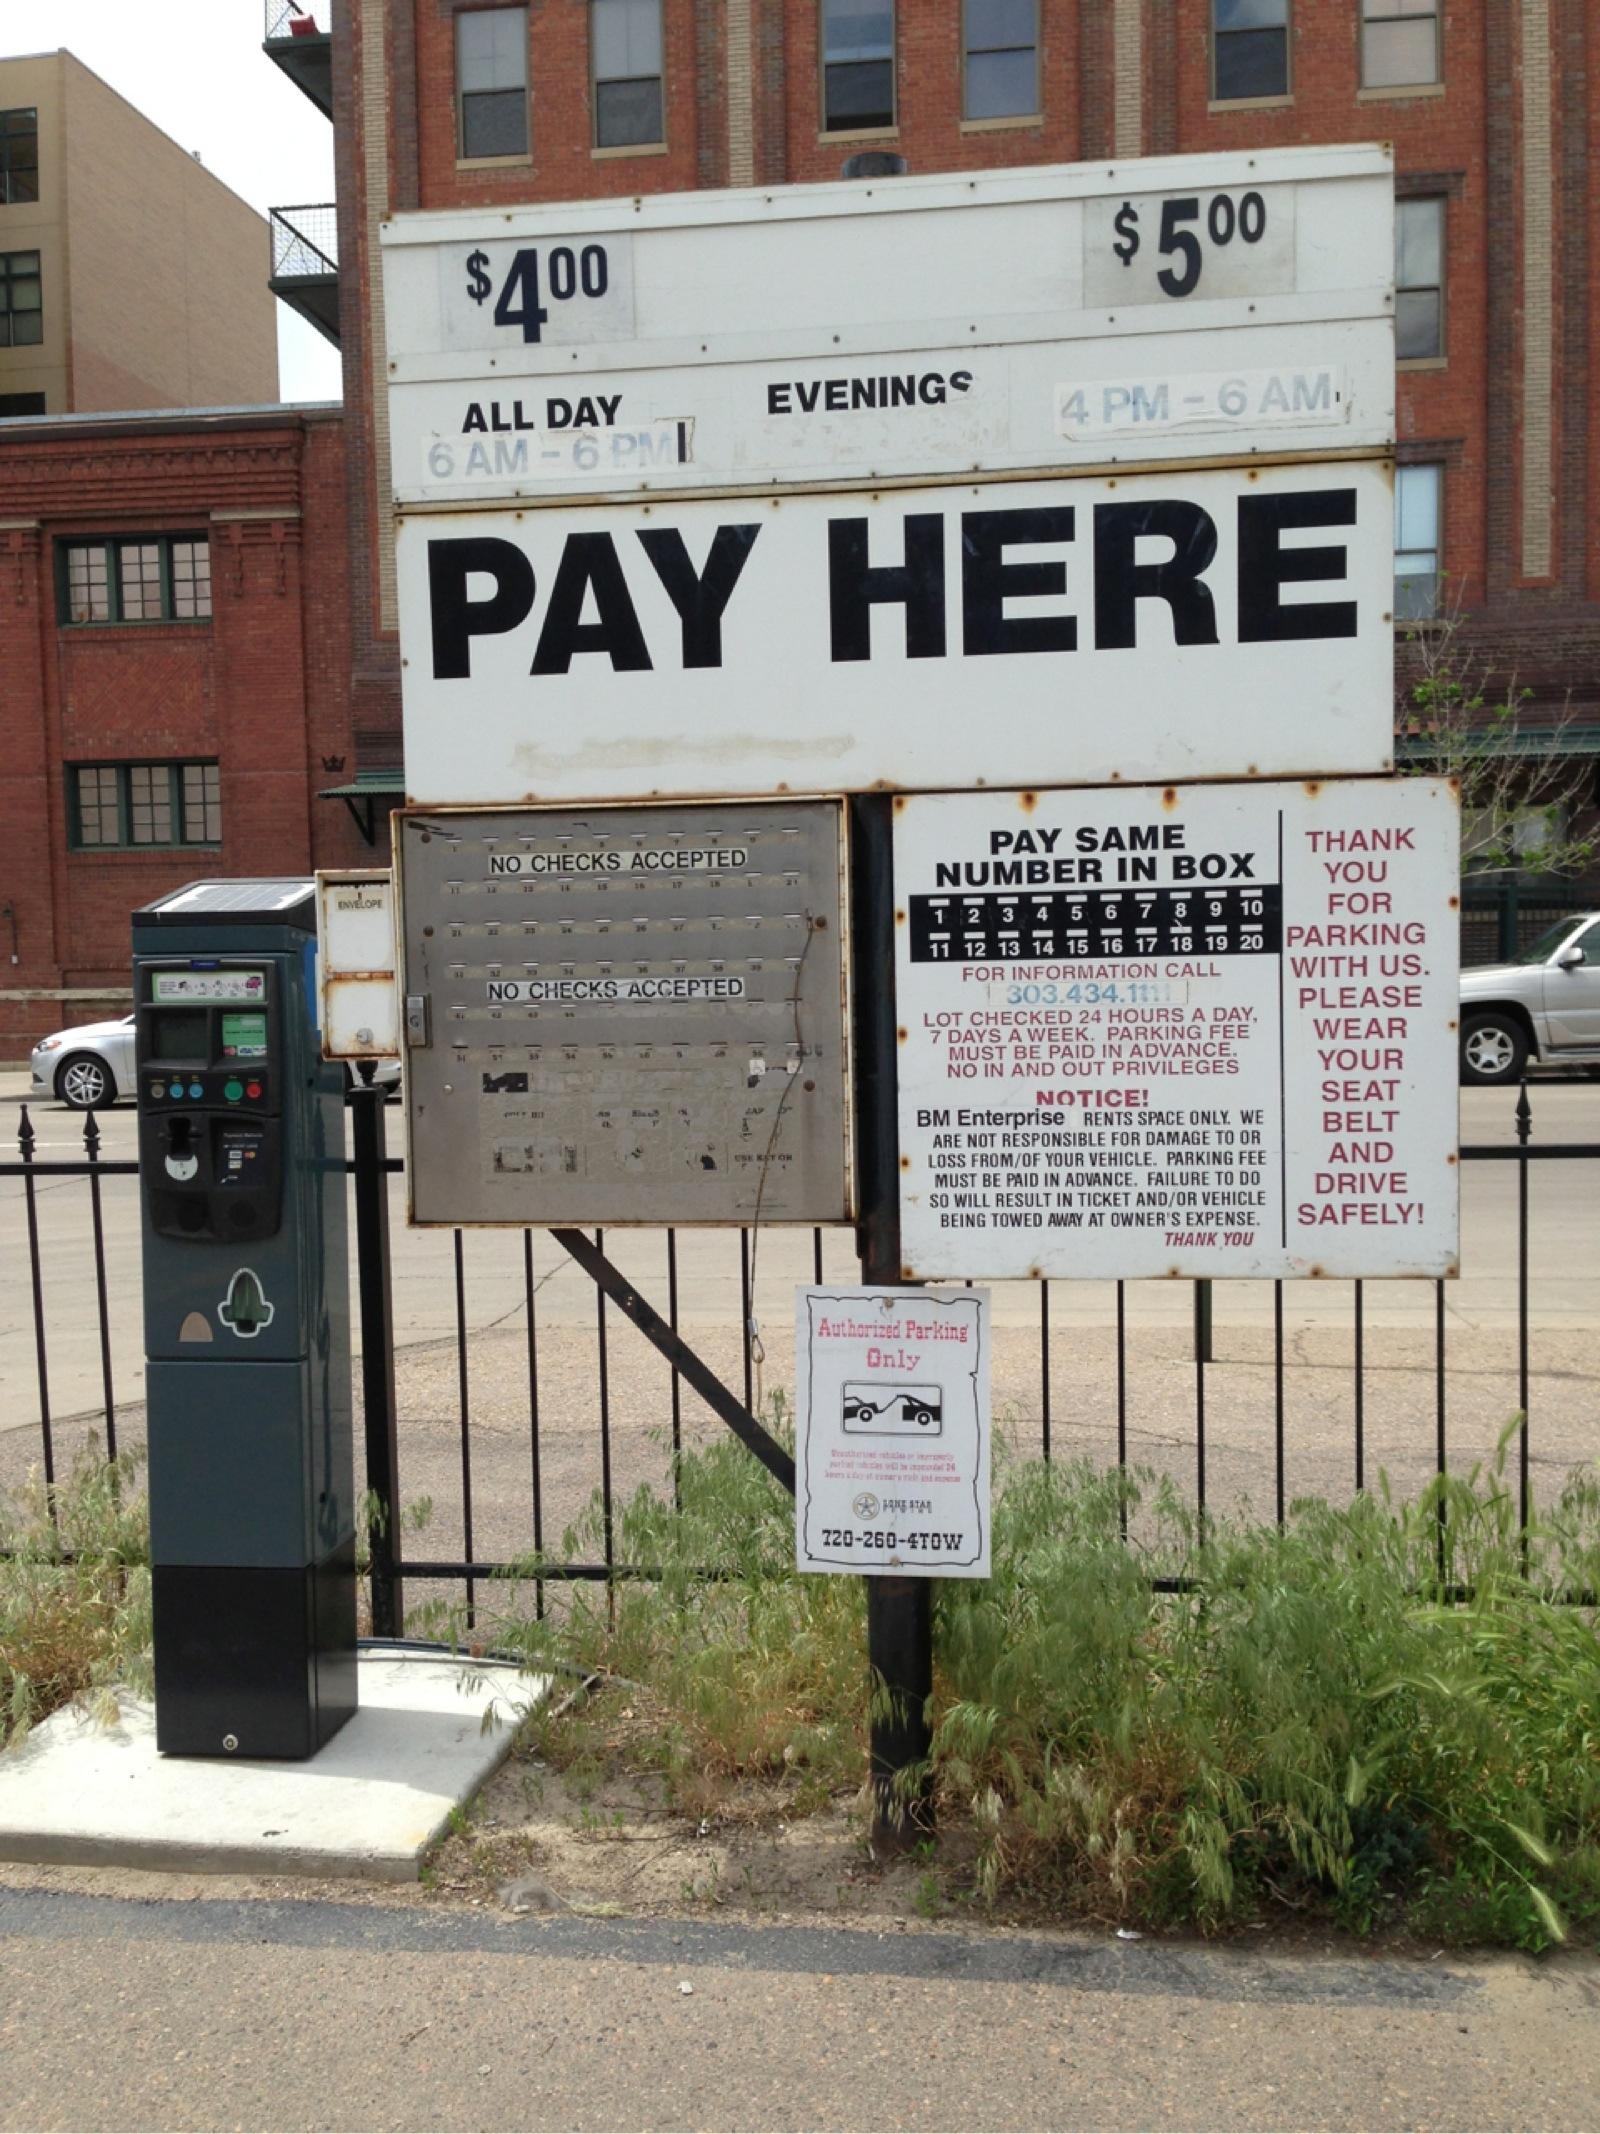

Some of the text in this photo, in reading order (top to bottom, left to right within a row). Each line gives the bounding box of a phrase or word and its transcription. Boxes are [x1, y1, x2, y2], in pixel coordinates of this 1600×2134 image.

[767, 370, 973, 414] EVENINGS
[1062, 389, 1088, 425] 4
[1104, 384, 1169, 424] PM
[1218, 379, 1247, 415] 6
[1259, 373, 1330, 413] AM
[462, 395, 622, 433] ALL DAY
[429, 441, 455, 478] 6
[465, 439, 528, 476] AM
[572, 434, 599, 470] 6
[612, 431, 672, 467] PM
[427, 488, 1358, 680] PAY HERE
[990, 825, 1185, 855] PAY SAME
[1305, 827, 1416, 853] THANK
[491, 850, 746, 873] NO CHECKS ACCEPTED
[936, 853, 1255, 887] NUMBER IN BOX
[1323, 861, 1388, 884] YOU
[935, 901, 1263, 923] 1 2 3 4 5 6 7 8 9 10
[1328, 892, 1393, 915] FOR
[929, 935, 1263, 958] 11 12 13 14 15 16 17 18 19 20
[1287, 922, 1427, 949] PARKING
[963, 963, 1222, 981] FOR INFORMATION CALL
[1290, 953, 1430, 978] WITH US.
[489, 979, 743, 999] NO CHECKS ACCEPTED
[1299, 986, 1422, 1010] PLEASE
[924, 1007, 1258, 1027] LOT CHECKED 24 HOURS A DAY,
[930, 1025, 1250, 1044] 7 DAYS A WEEK. PARKING FEE
[1313, 1017, 1408, 1041] WEAR
[949, 1042, 1237, 1061] MUST BE PAID IN ADVANCE.
[1317, 1049, 1404, 1072] YOUR
[948, 1059, 1239, 1078] NO IN AND OUT PRIVILEGES
[1036, 1089, 1148, 1108] NOTICE!
[1321, 1079, 1401, 1103] SEAT
[917, 1109, 1264, 1130] BM Enterprise RENTS SPACE ONLY. WE
[1323, 1111, 1400, 1134] BELT
[933, 1130, 1261, 1148] ARE NOT RESPONSIBLE FOR DAMAGE TO OR
[928, 1150, 1266, 1168] LOSS FROM/OF YOUR VEHICLE. PARKING FEE
[1328, 1141, 1394, 1164] AND
[935, 1170, 1261, 1188] MUST BE PAID IN ADVANCE. FAILURE TO DO
[1315, 1172, 1408, 1195] DRIVE
[929, 1191, 1266, 1208] SO WILL RESULT IN TICKET AND/OR VEHICLE
[941, 1210, 1260, 1228] BEING TOWED AWAY AT OWNER'S EXPENSE.
[1297, 1203, 1425, 1226] SAFELY!
[1164, 1232, 1254, 1247] THANK YOU
[818, 1318, 969, 1343] Authorized Parking
[866, 1347, 921, 1372] Only
[822, 1530, 964, 1551] 720-260-4TOW
